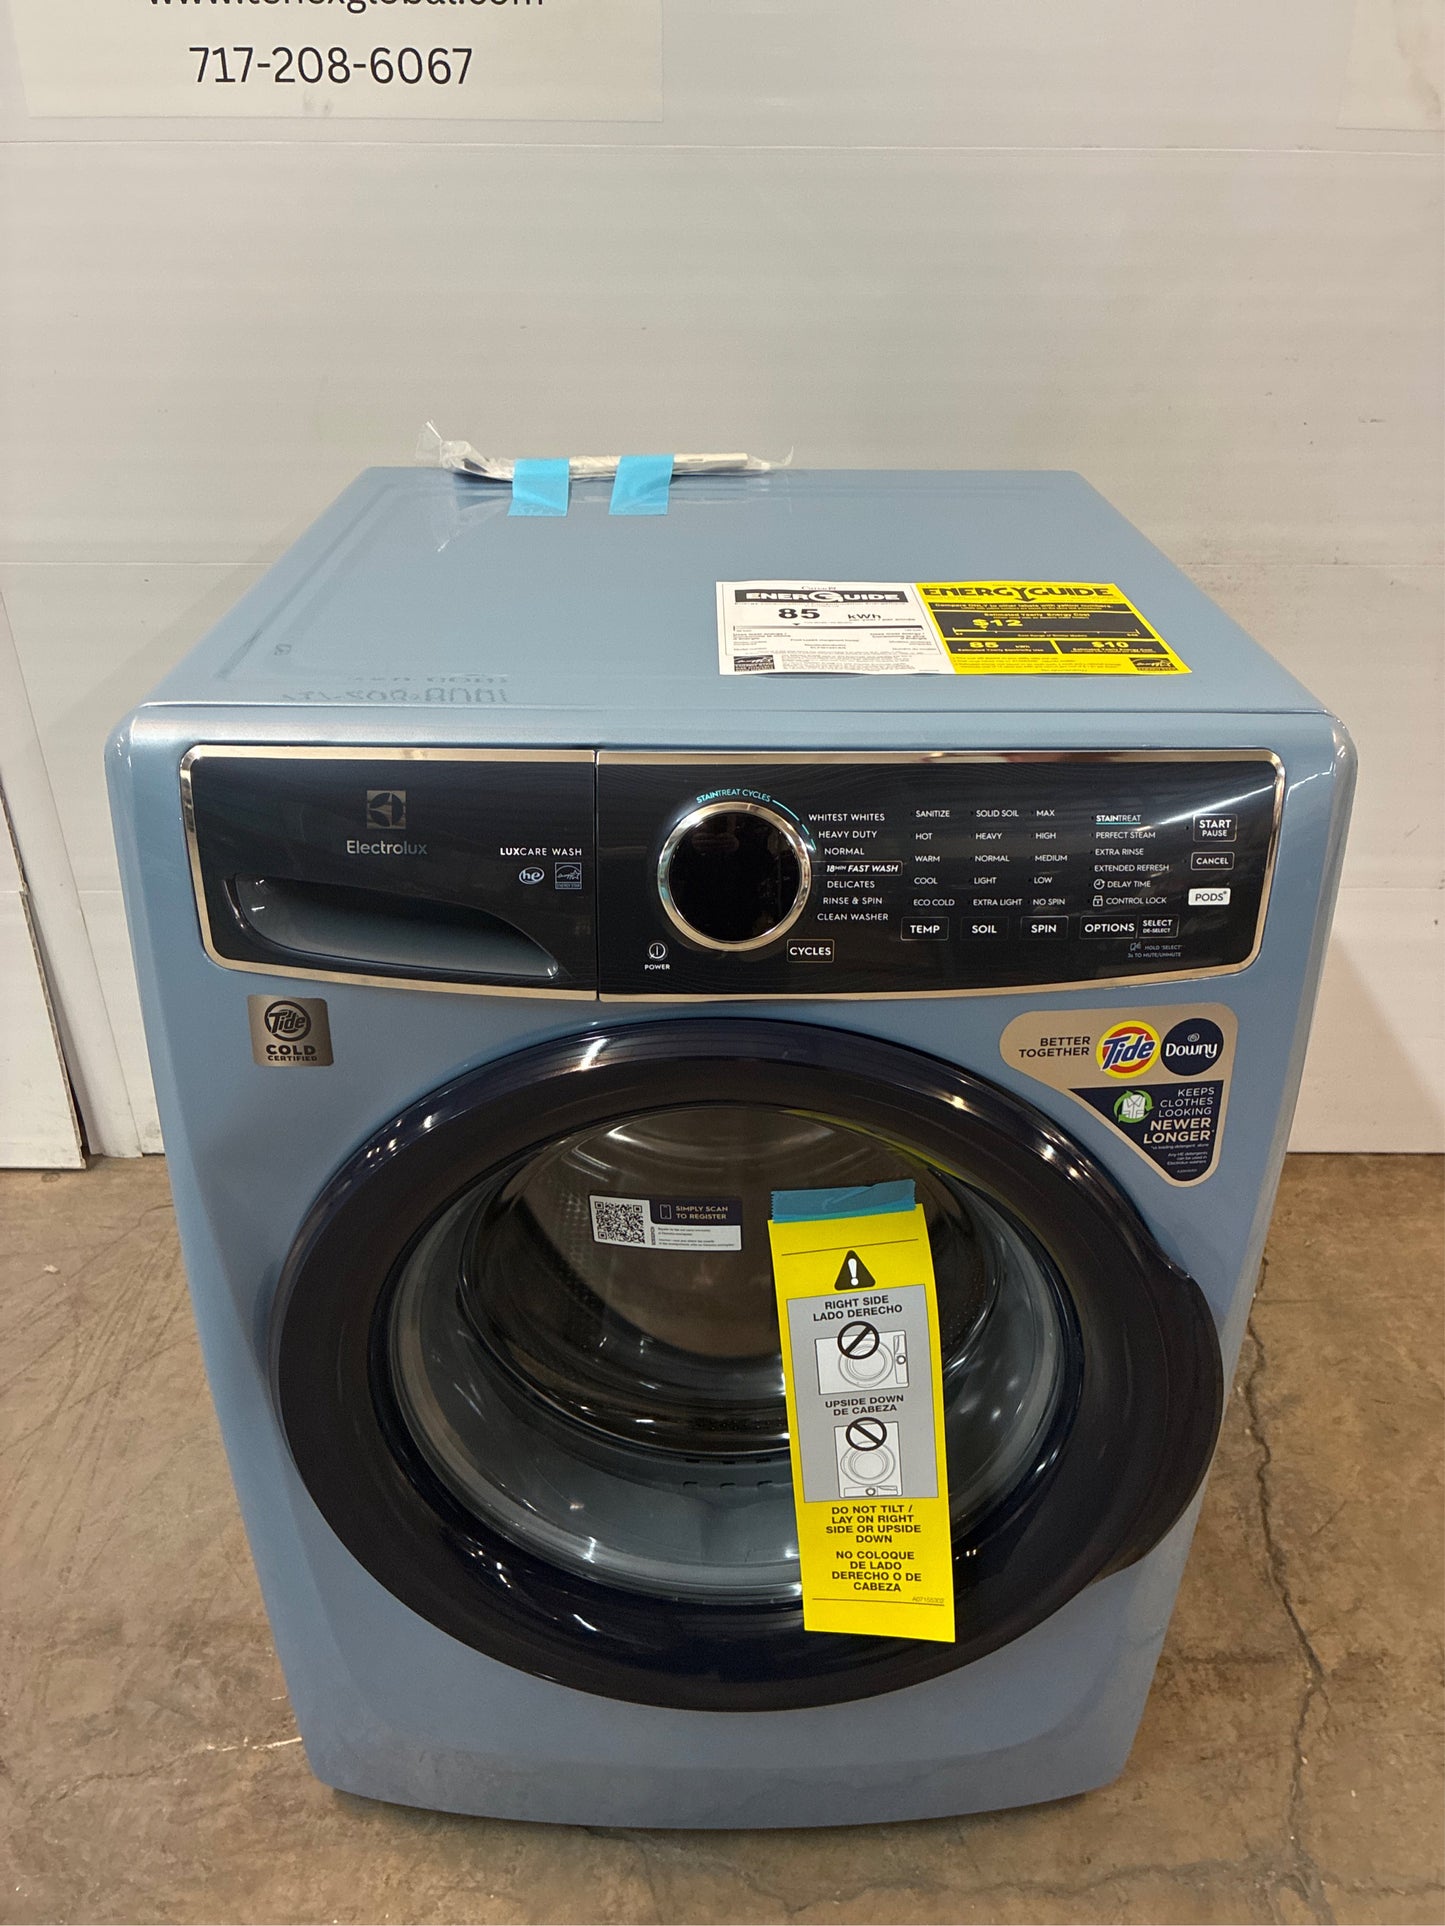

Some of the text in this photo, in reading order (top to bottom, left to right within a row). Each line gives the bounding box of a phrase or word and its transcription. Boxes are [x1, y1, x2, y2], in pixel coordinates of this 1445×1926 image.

[188, 47, 473, 85] 717-208-6067
[922, 587, 1114, 601] ENERGYGUIDE
[778, 608, 820, 619] 85
[972, 618, 1023, 628] $12
[696, 788, 771, 803] STAINTREAT CYCLES
[808, 813, 885, 822] WHITEST WHITES
[1199, 820, 1232, 828] START
[852, 830, 878, 838] DUTY
[346, 840, 428, 855] Electrolux
[500, 848, 582, 856] LUXCARE WASH
[824, 848, 864, 856] NORMAL
[1196, 857, 1229, 865] CANCEL
[522, 870, 540, 882] he
[827, 880, 875, 888] DELICATES
[910, 925, 940, 934] TEMP
[972, 925, 997, 934] SOIL
[1031, 924, 1056, 933] SPIN
[1084, 923, 1135, 932] OPTIONS
[790, 946, 832, 956] CYCLES
[268, 1009, 306, 1034] Tide
[1040, 1036, 1091, 1047] BETTER
[266, 1044, 316, 1055] COLD
[1019, 1046, 1090, 1058] TOGETHER
[1100, 1033, 1155, 1071] Tide
[1165, 1042, 1218, 1058] Downy
[1178, 1087, 1214, 1096] KEEPS
[1160, 1097, 1214, 1108] CLOTHES
[1159, 1107, 1212, 1118] LOOKING
[1150, 1117, 1212, 1131] NEWER
[824, 1295, 889, 1310] RIGHT SIDE
[813, 1304, 903, 1322] LADO DERECHO
[825, 1394, 904, 1409] UPSIDE DOWN
[834, 1404, 898, 1416] DE CABEZA
[832, 1504, 913, 1515] DO NOT TILT /
[832, 1514, 914, 1524] LAY ON RIGHT
[826, 1524, 922, 1534] SIDE OR UPSIDE
[856, 1535, 893, 1544] DOWN
[836, 1551, 914, 1560] NO COLOQUE
[850, 1561, 902, 1570] DE LADO
[832, 1571, 922, 1582] DERECHO O DE
[854, 1582, 902, 1592] CABEZA
